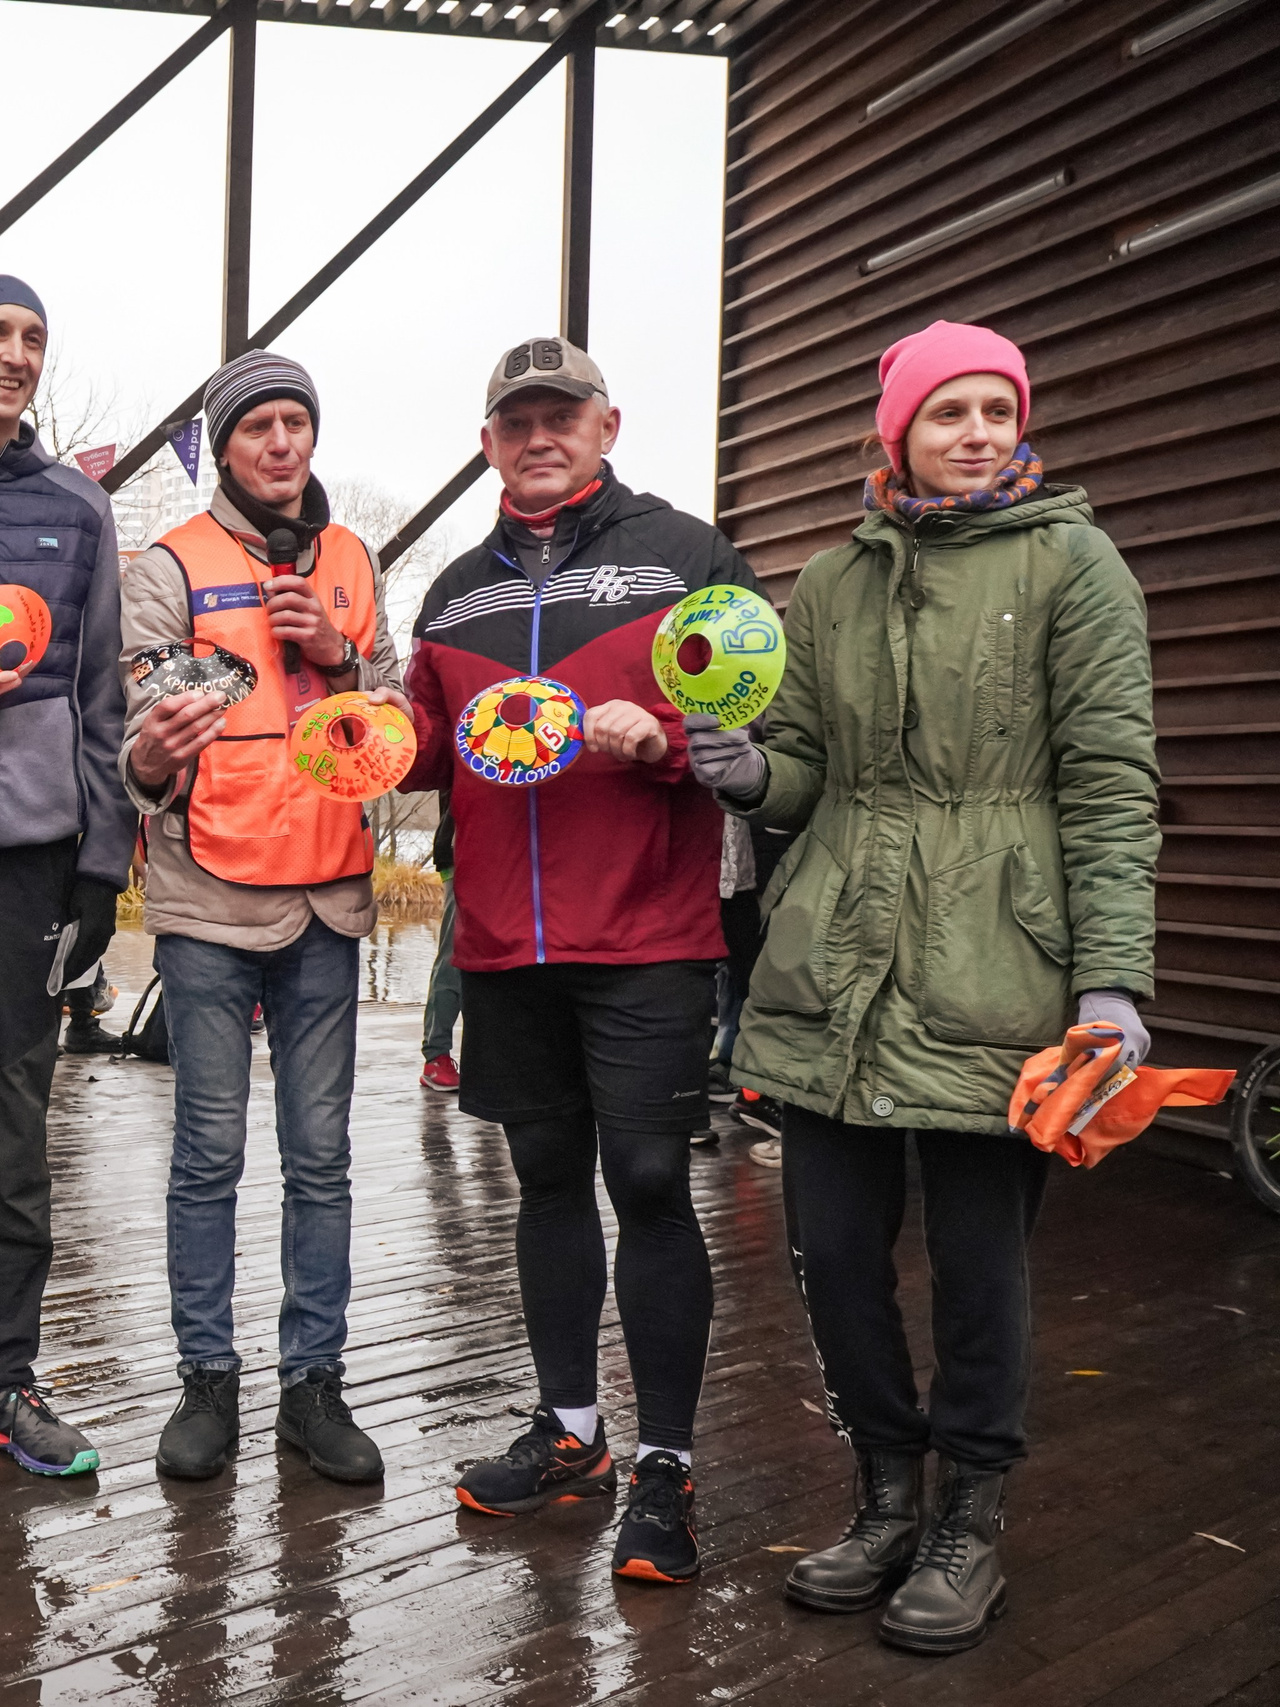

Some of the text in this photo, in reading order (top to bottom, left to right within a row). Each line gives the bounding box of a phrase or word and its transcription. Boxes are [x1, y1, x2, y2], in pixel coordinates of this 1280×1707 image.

[505, 341, 562, 379] 66
[89, 460, 106, 469] утро
[540, 724, 563, 750] 5
